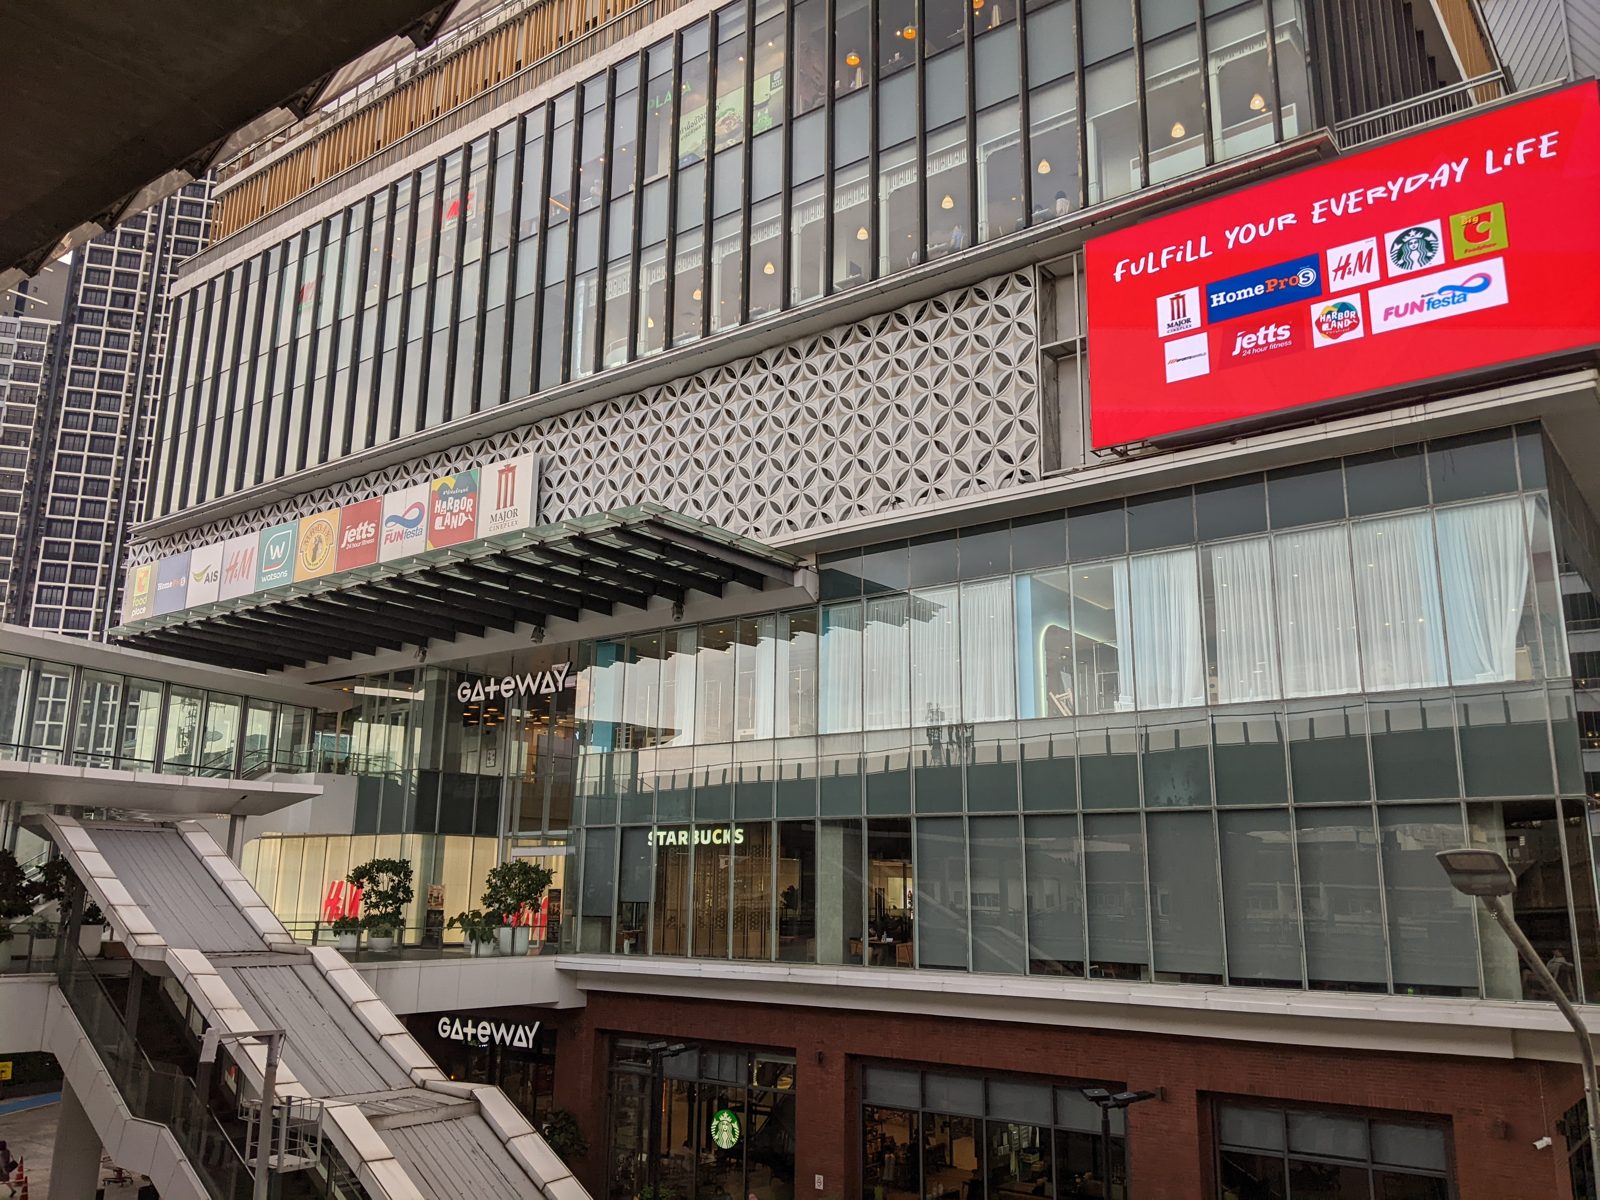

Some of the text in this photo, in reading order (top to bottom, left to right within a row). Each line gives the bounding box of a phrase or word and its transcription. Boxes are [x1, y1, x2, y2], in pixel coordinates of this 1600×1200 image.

[1224, 213, 1297, 249] YOUR
[1310, 157, 1469, 224] EVERYDAY
[1332, 247, 1374, 282] H&M
[1166, 317, 1192, 329] MAJOR
[1320, 310, 1356, 323] HARBOR
[1321, 319, 1351, 331] LAND
[1232, 323, 1291, 356] jetts
[1242, 340, 1292, 357] 24 hour fitness
[434, 496, 474, 515] HARBOR
[434, 512, 466, 531] LAND
[489, 508, 519, 524] MAJOR
[341, 520, 376, 548] jetts
[488, 520, 518, 532] CINEPLEX
[224, 546, 255, 585] H&M
[203, 571, 219, 584] AIS
[261, 570, 288, 583] watsons
